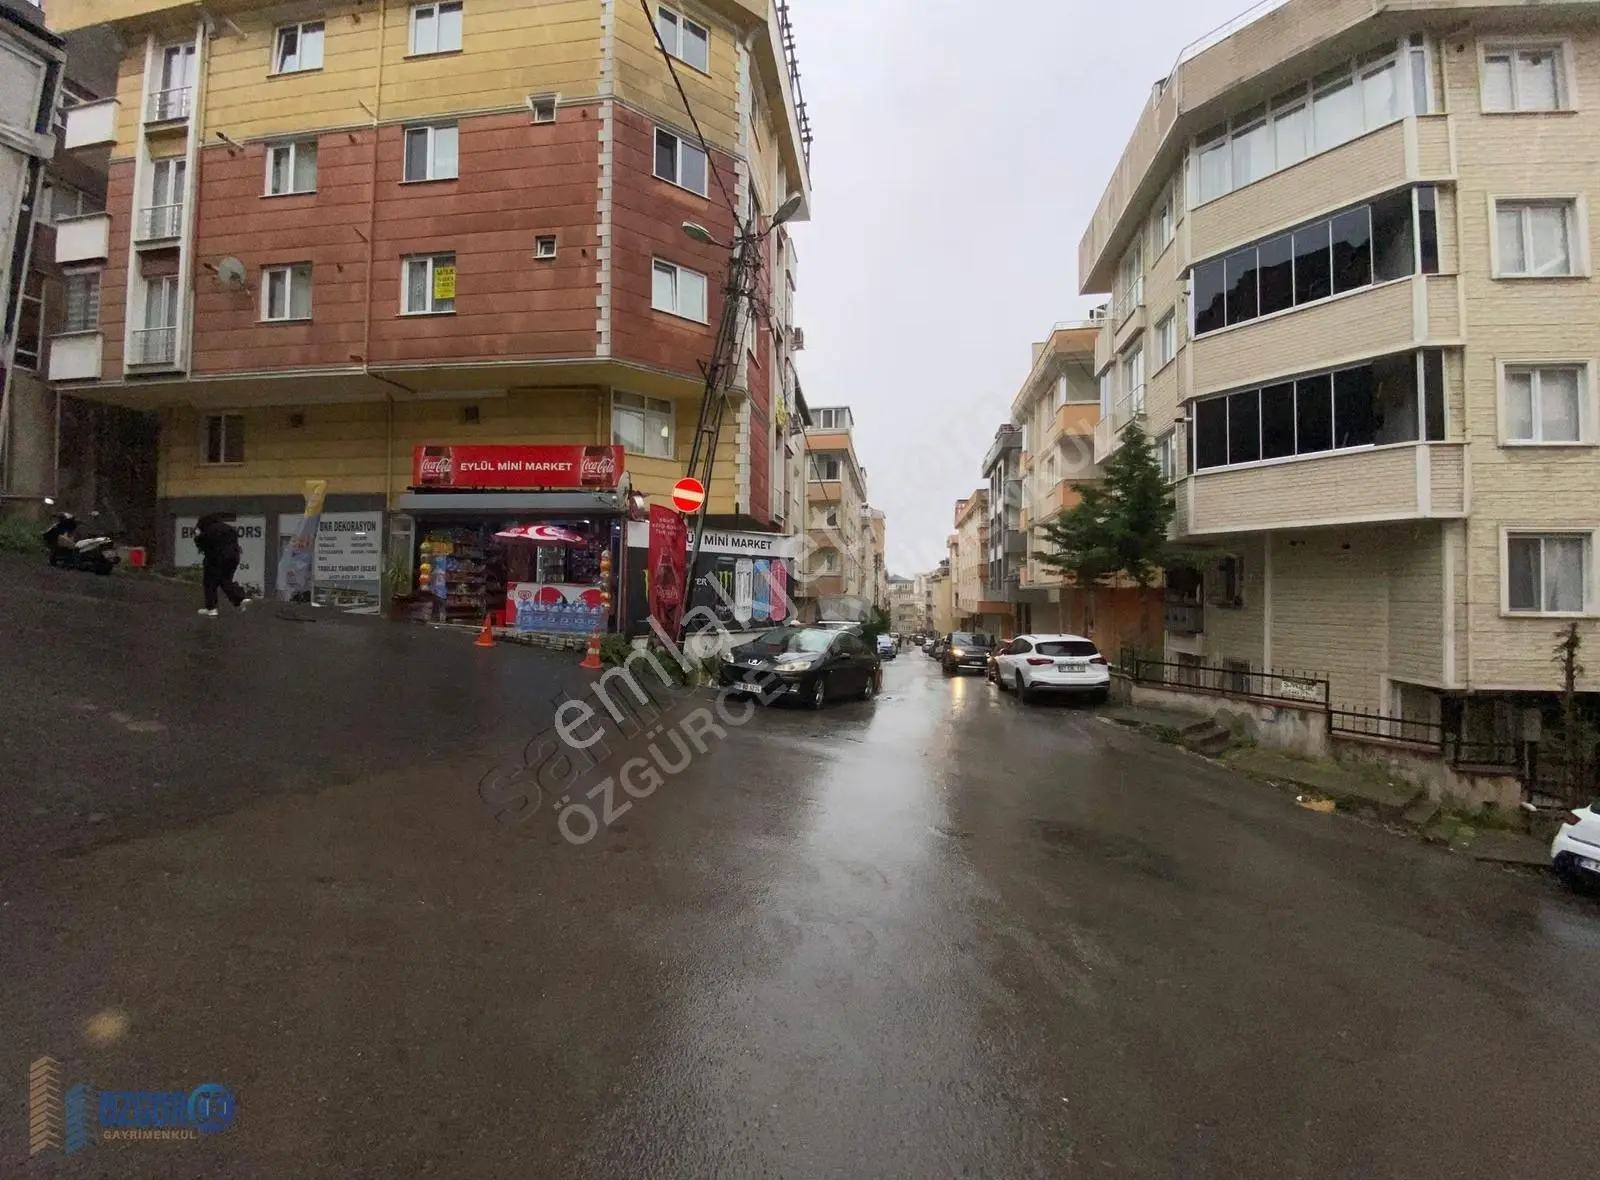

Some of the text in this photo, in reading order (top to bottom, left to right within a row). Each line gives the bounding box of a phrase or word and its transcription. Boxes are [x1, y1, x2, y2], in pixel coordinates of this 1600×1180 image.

[460, 460, 573, 471] EYLÜL MİNİ MARKET
[334, 520, 377, 532] DEKORASYON
[704, 533, 729, 547] MİNİ
[731, 538, 773, 550] MARKET
